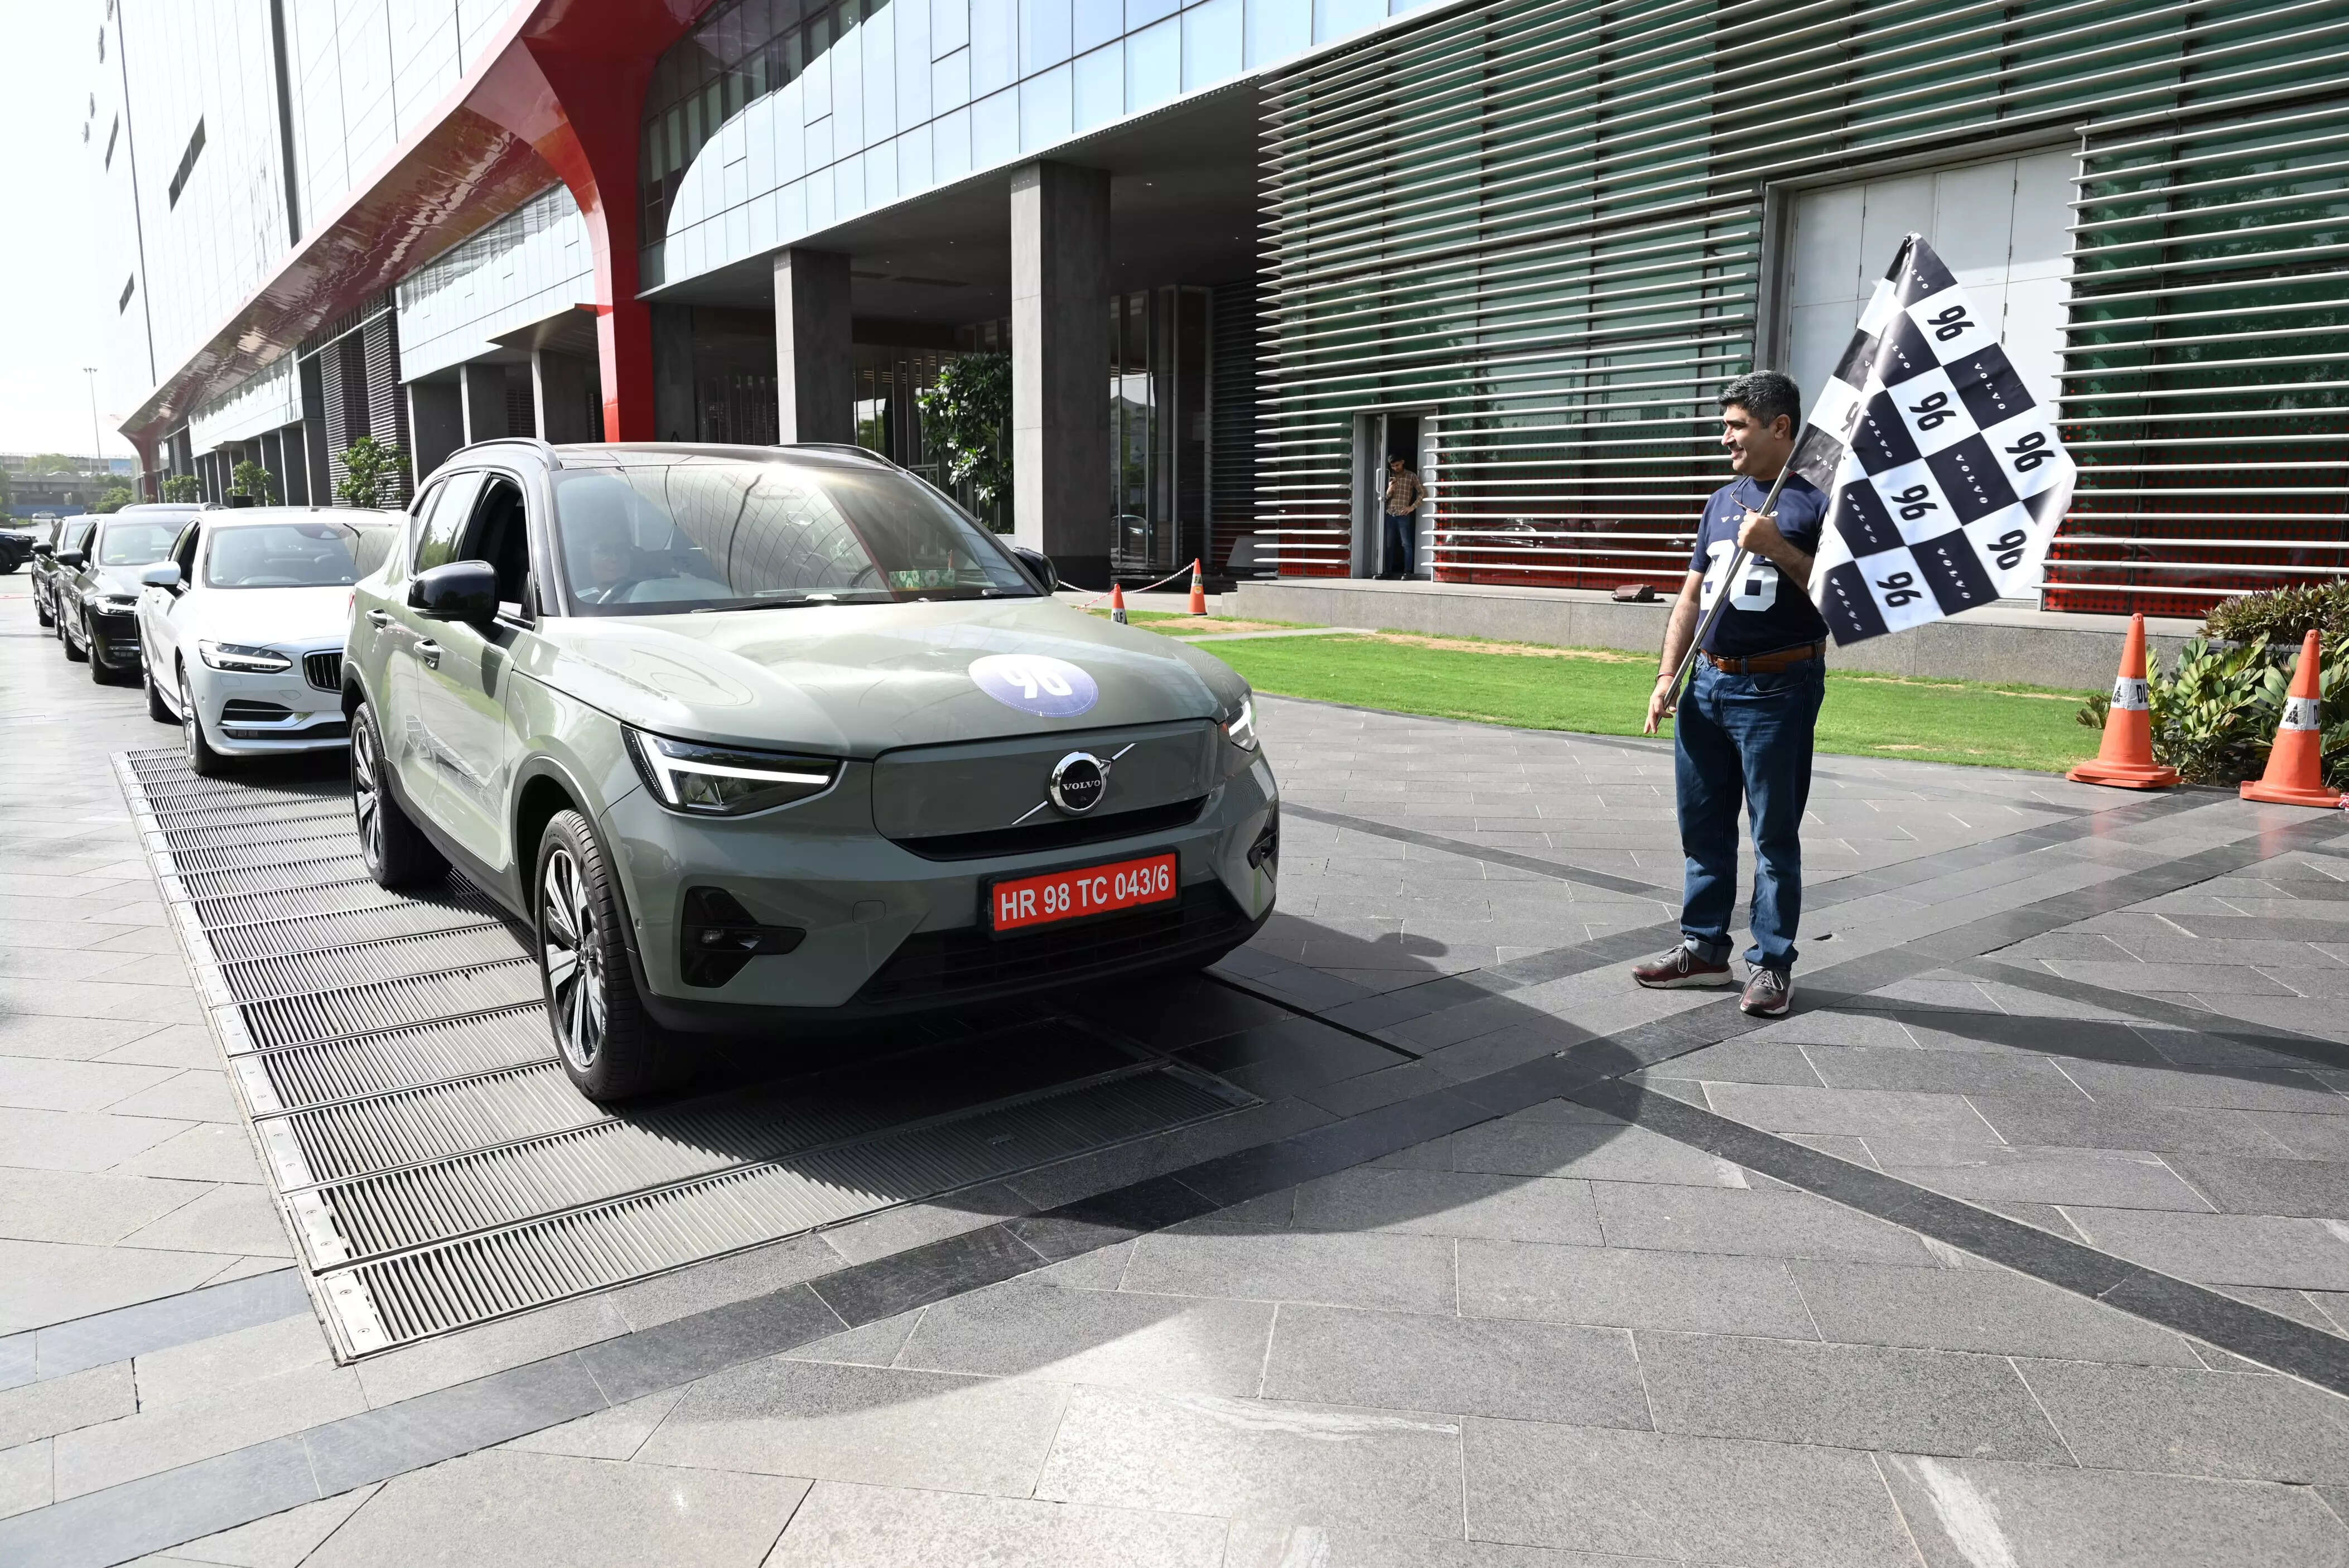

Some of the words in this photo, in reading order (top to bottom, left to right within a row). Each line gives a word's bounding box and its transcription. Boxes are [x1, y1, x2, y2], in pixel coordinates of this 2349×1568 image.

[1927, 305, 1975, 342] 96
[1974, 362, 2006, 410] VOLVO
[1908, 392, 1957, 431] 96
[1863, 409, 1893, 458] VOLVO
[2004, 431, 2056, 473] 96
[1816, 455, 1833, 471] VOL
[1955, 453, 1988, 504] VOLVO
[1846, 493, 1878, 543] VOLVO
[1890, 484, 1938, 520] 96
[1986, 529, 2027, 570] 96
[1875, 572, 1923, 607] 96
[1937, 547, 1971, 599] VOLVO
[1831, 577, 1863, 631] VOLVO
[1062, 780, 1101, 790] VOLVO
[1002, 889, 1037, 921] HR
[1044, 883, 1070, 914] 98
[1077, 876, 1107, 907] TC
